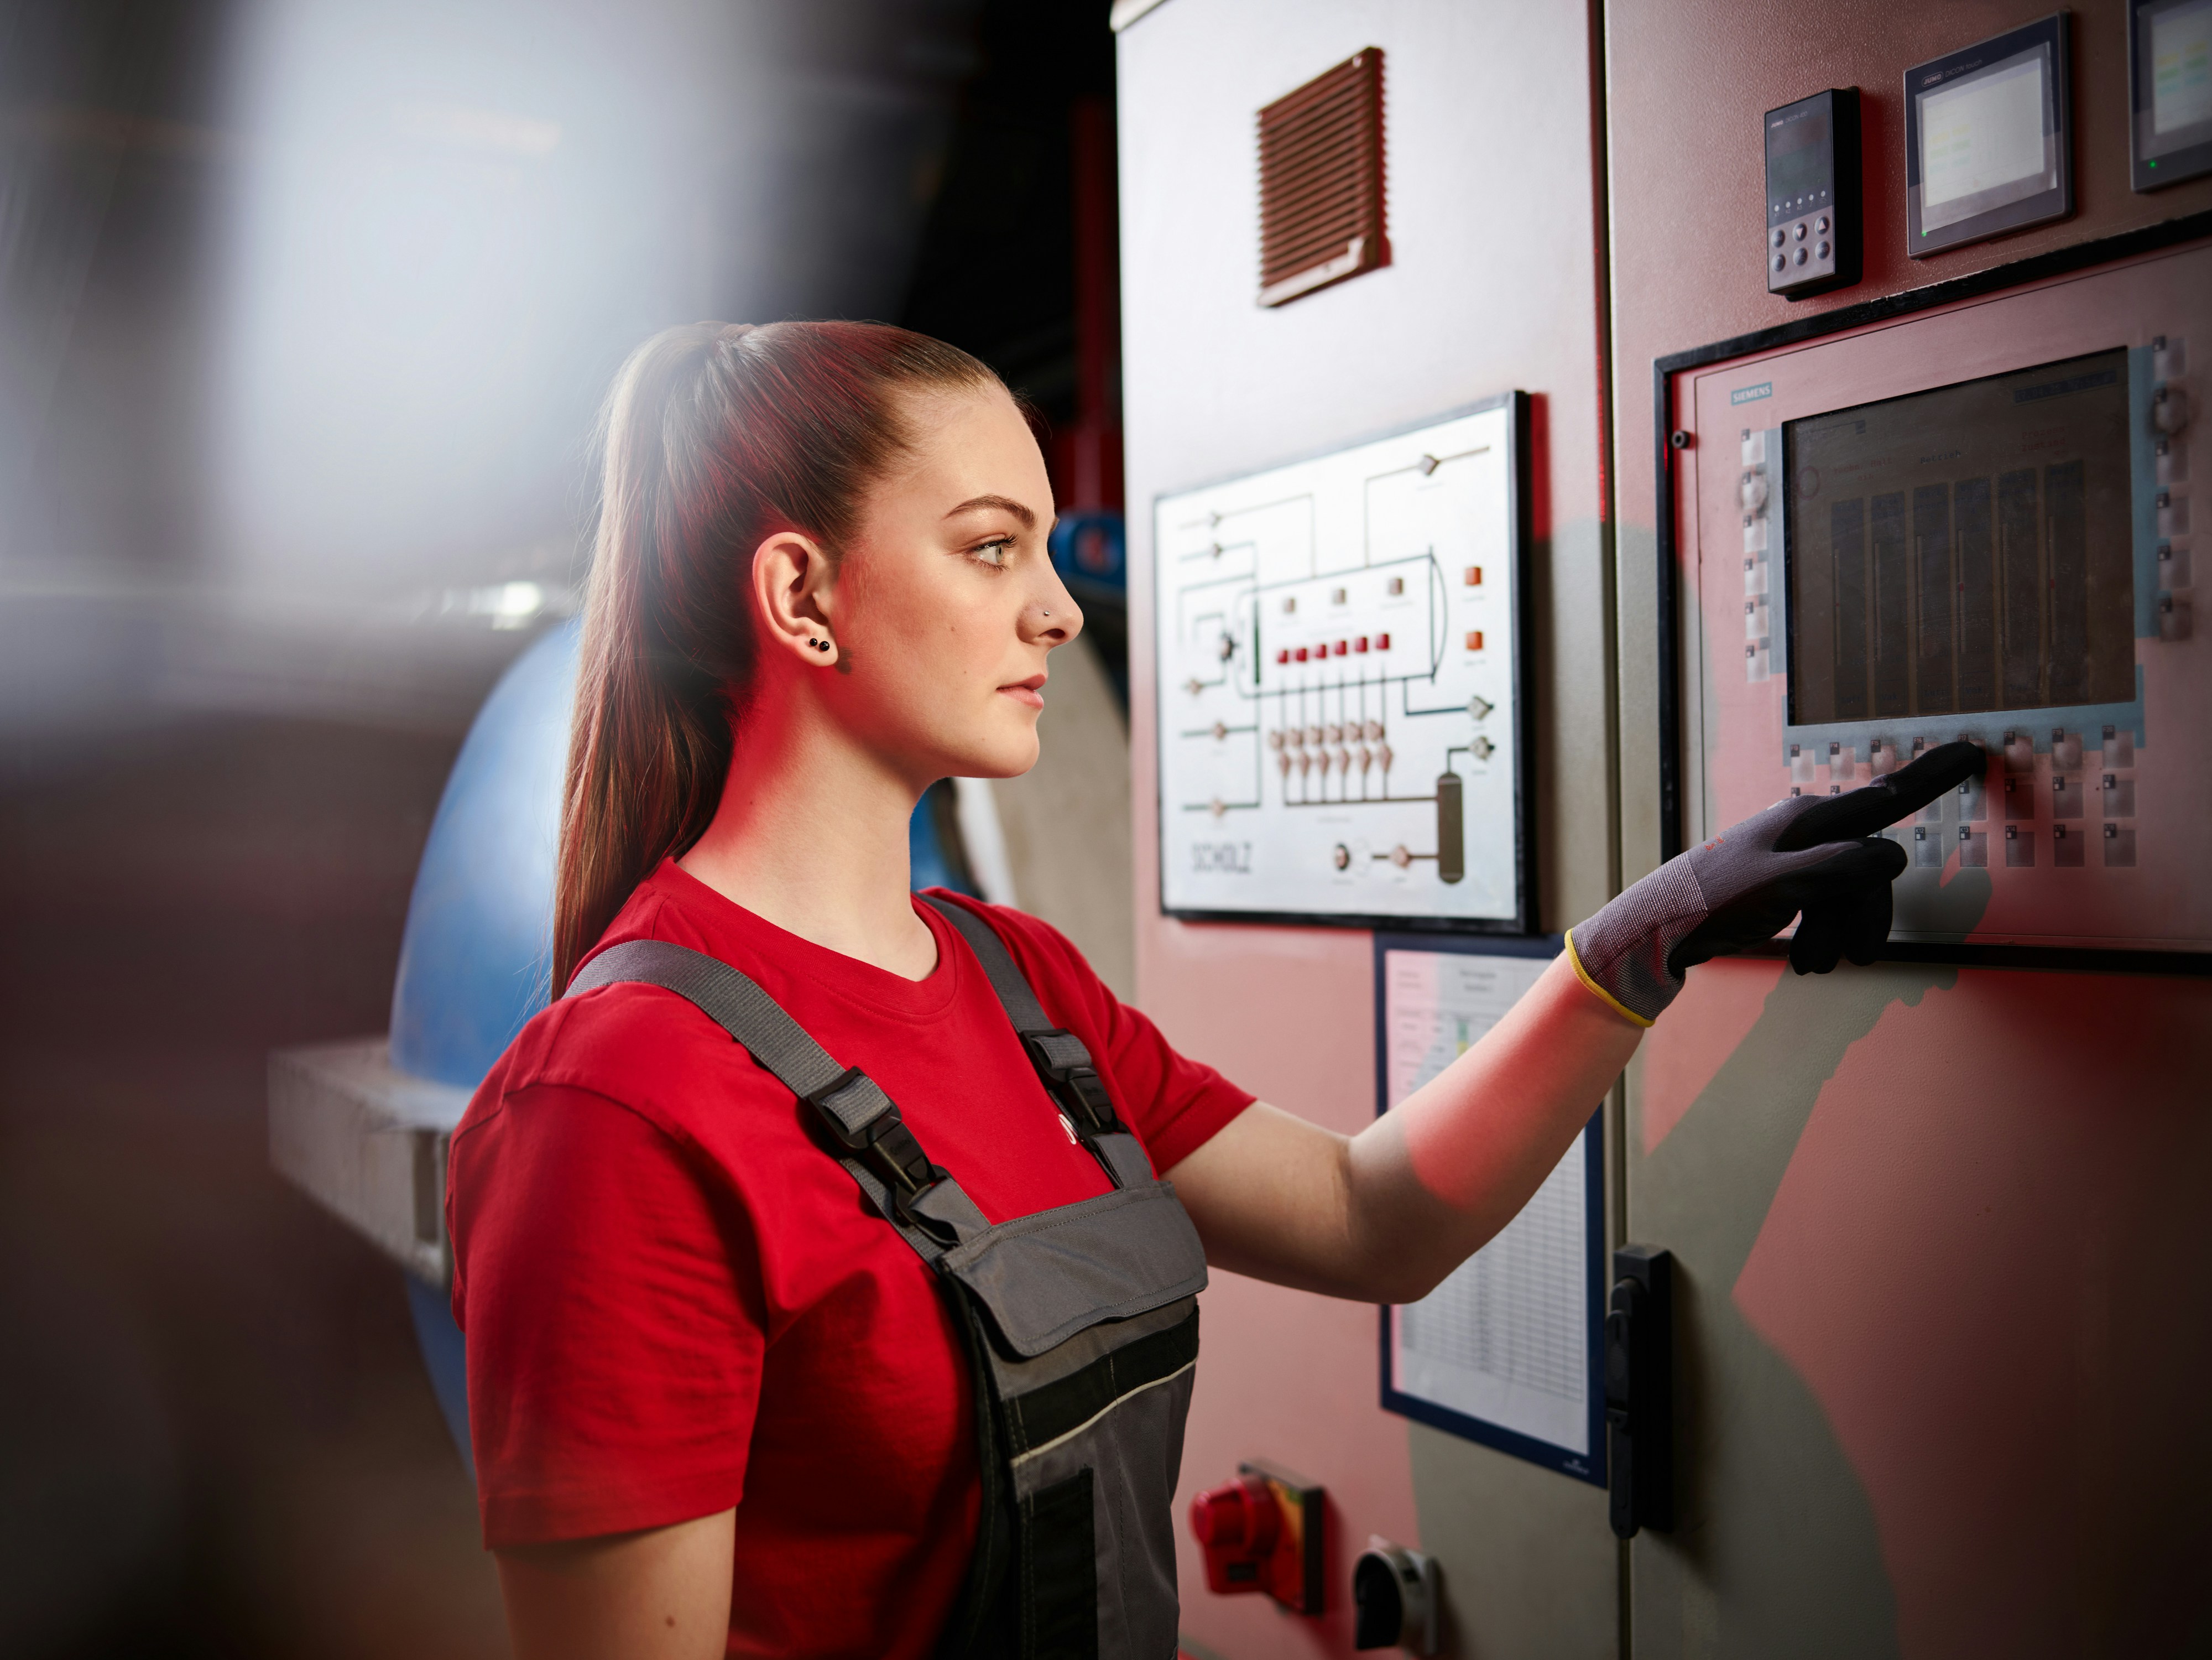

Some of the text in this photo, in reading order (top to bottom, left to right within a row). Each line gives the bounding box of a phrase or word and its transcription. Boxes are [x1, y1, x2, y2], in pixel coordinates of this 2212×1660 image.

[1923, 59, 1982, 85] JUMO DICON touch
[1733, 385, 1770, 403] SIEMENS
[2022, 436, 2065, 452] Zustand
[1920, 450, 1961, 464] Betrieb
